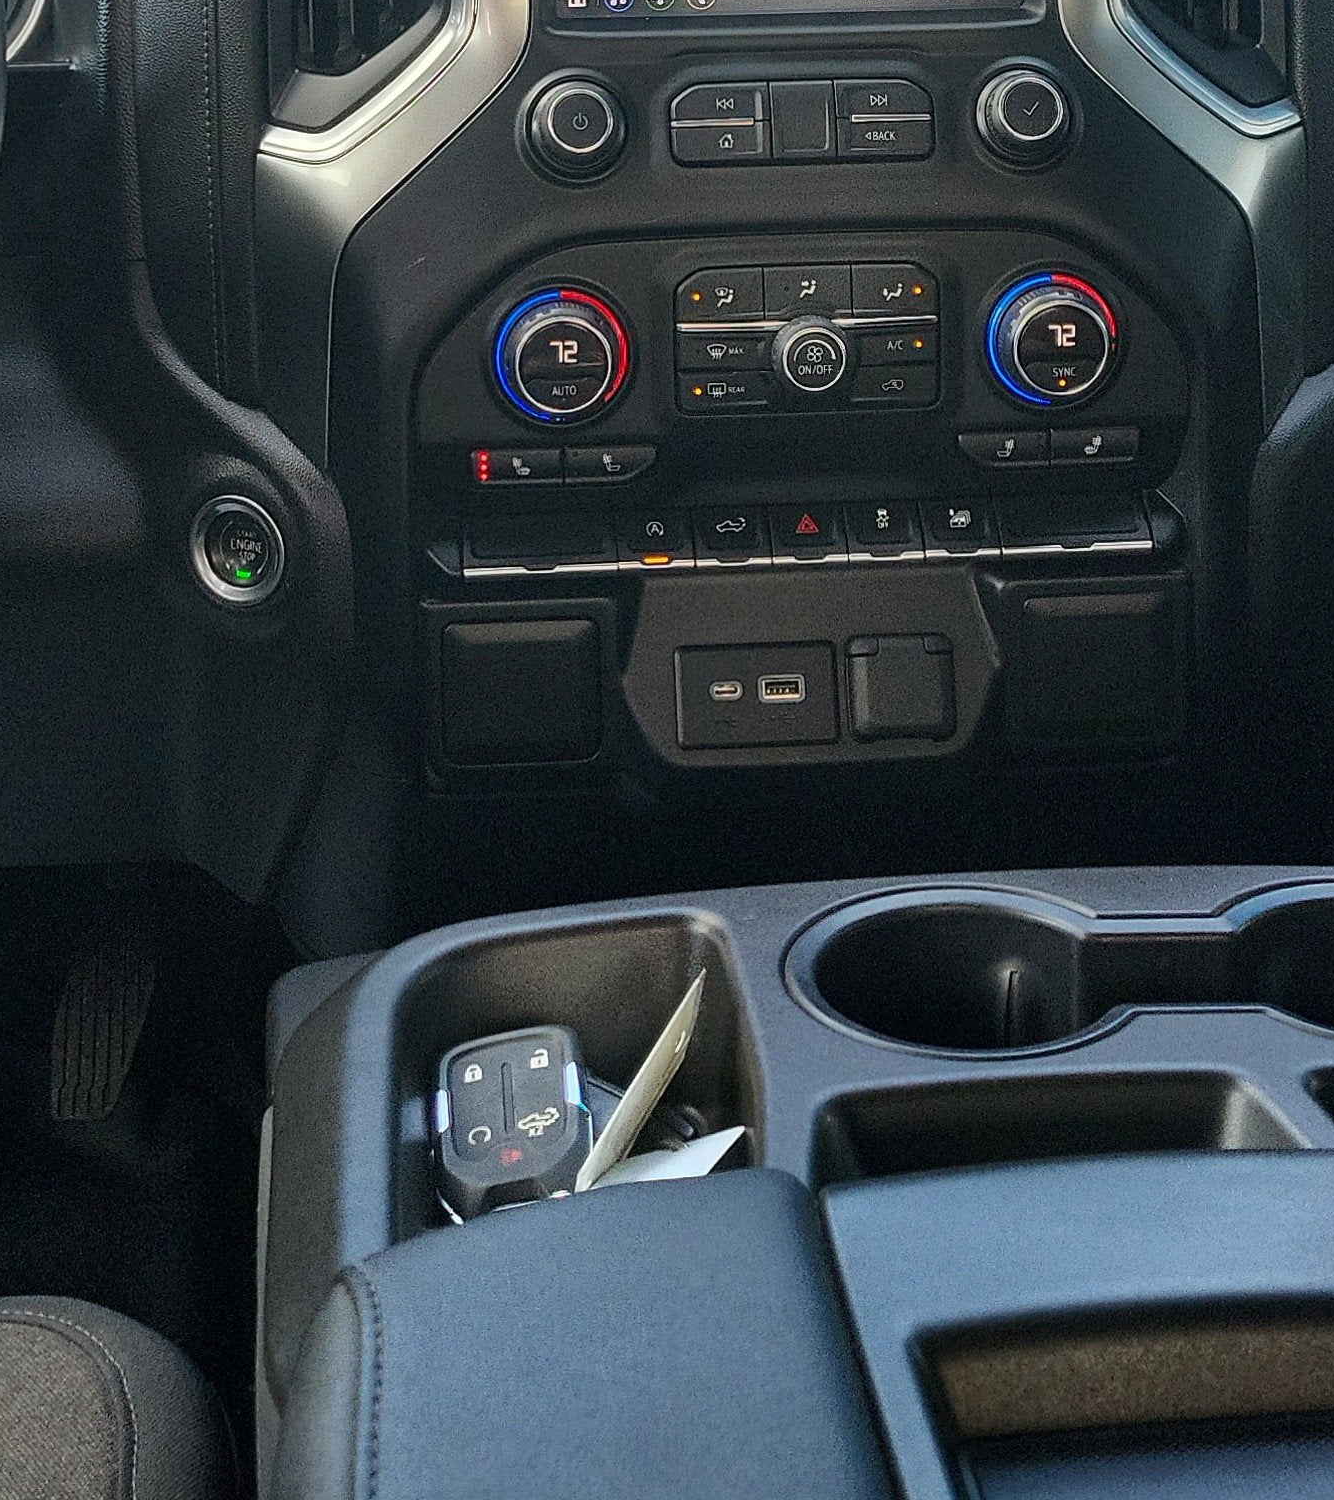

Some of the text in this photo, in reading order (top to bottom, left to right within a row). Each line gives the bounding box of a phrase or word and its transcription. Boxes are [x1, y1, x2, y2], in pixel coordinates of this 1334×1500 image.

[871, 130, 897, 142] BACK
[1048, 323, 1077, 347] 72
[549, 339, 578, 364] 72
[886, 340, 906, 351] A/C
[797, 364, 834, 376] ON/OFF
[1052, 366, 1078, 378] SYNC
[551, 384, 577, 397] AUTO
[727, 385, 746, 394] REAR
[230, 538, 263, 554] ENGINE
[238, 551, 257, 562] STOP
